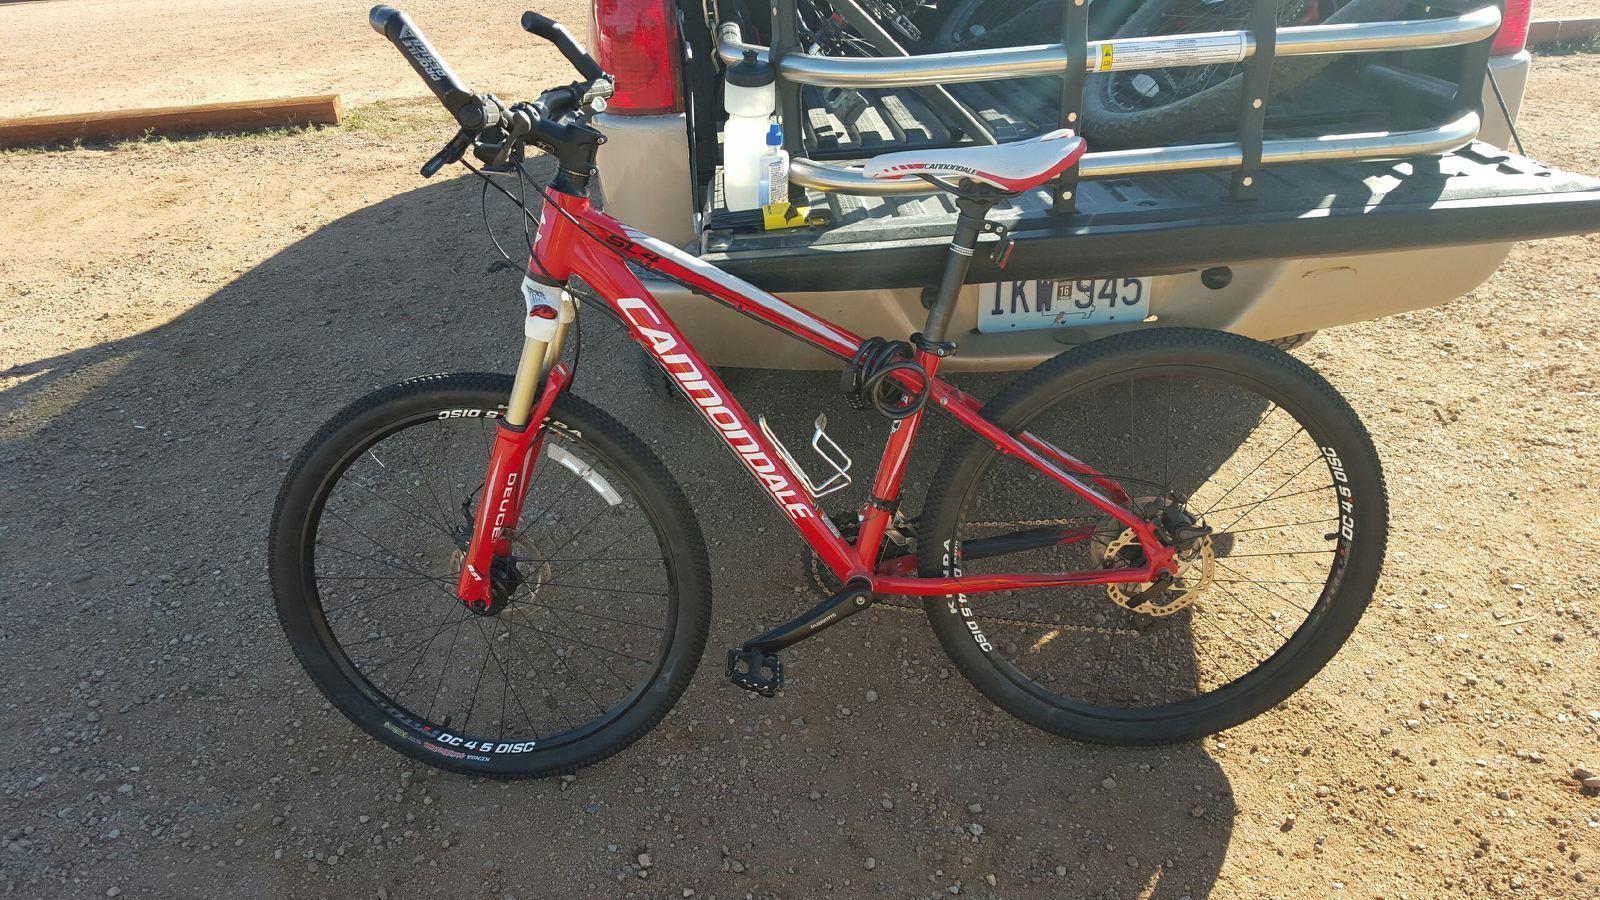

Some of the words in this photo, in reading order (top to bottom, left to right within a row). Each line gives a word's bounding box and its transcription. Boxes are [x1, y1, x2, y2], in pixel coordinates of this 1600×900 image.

[401, 40, 441, 81] PROFILE
[923, 163, 978, 176] CANNONDALE
[1059, 285, 1070, 297] 16
[1074, 277, 1143, 309] 945
[438, 409, 482, 420] DISC
[1321, 446, 1348, 483] DISC
[491, 472, 518, 538] DEUCE
[1341, 514, 1354, 541] DC
[966, 620, 993, 652] DISC
[437, 733, 463, 747] DC
[494, 741, 536, 754] DISC
